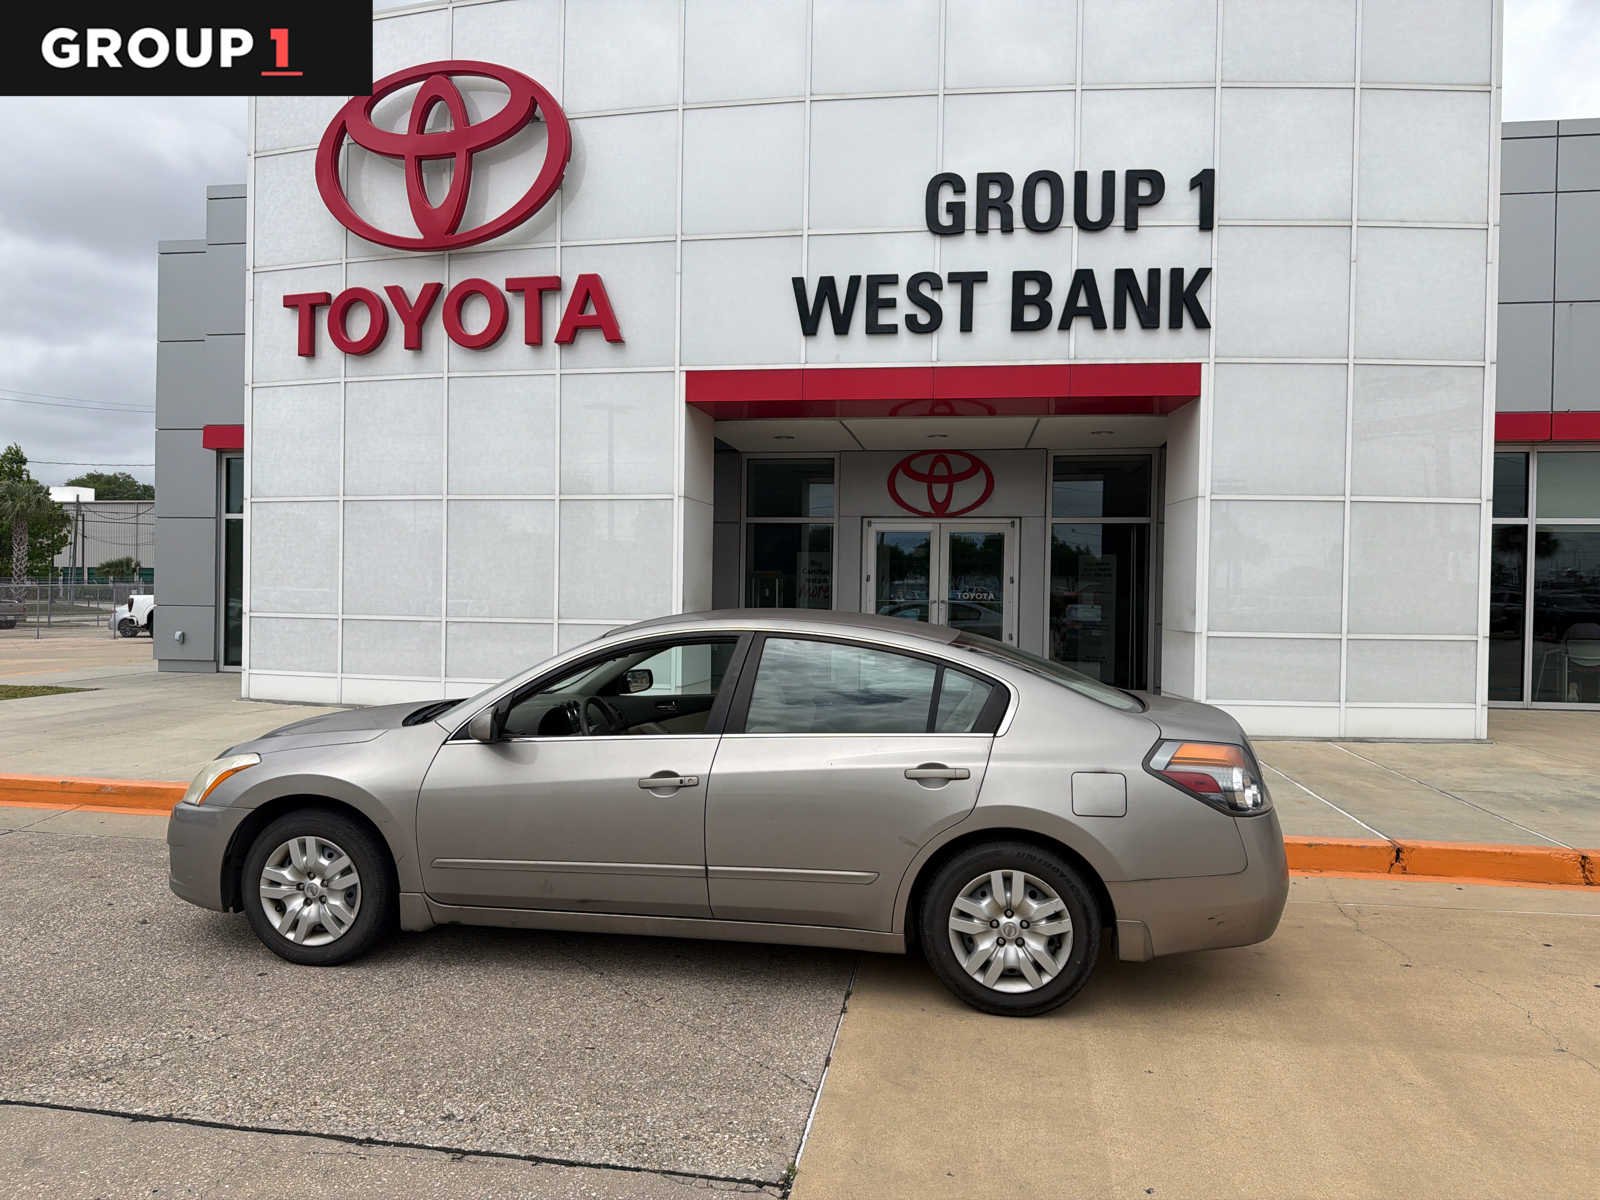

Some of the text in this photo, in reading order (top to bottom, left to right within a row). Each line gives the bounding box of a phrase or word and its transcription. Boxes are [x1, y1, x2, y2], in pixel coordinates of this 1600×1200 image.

[925, 168, 1216, 236] GROUP 1
[283, 273, 625, 358] TOYOTA
[791, 267, 1212, 337] WEST BANK
[956, 592, 994, 600] TOYOTA
